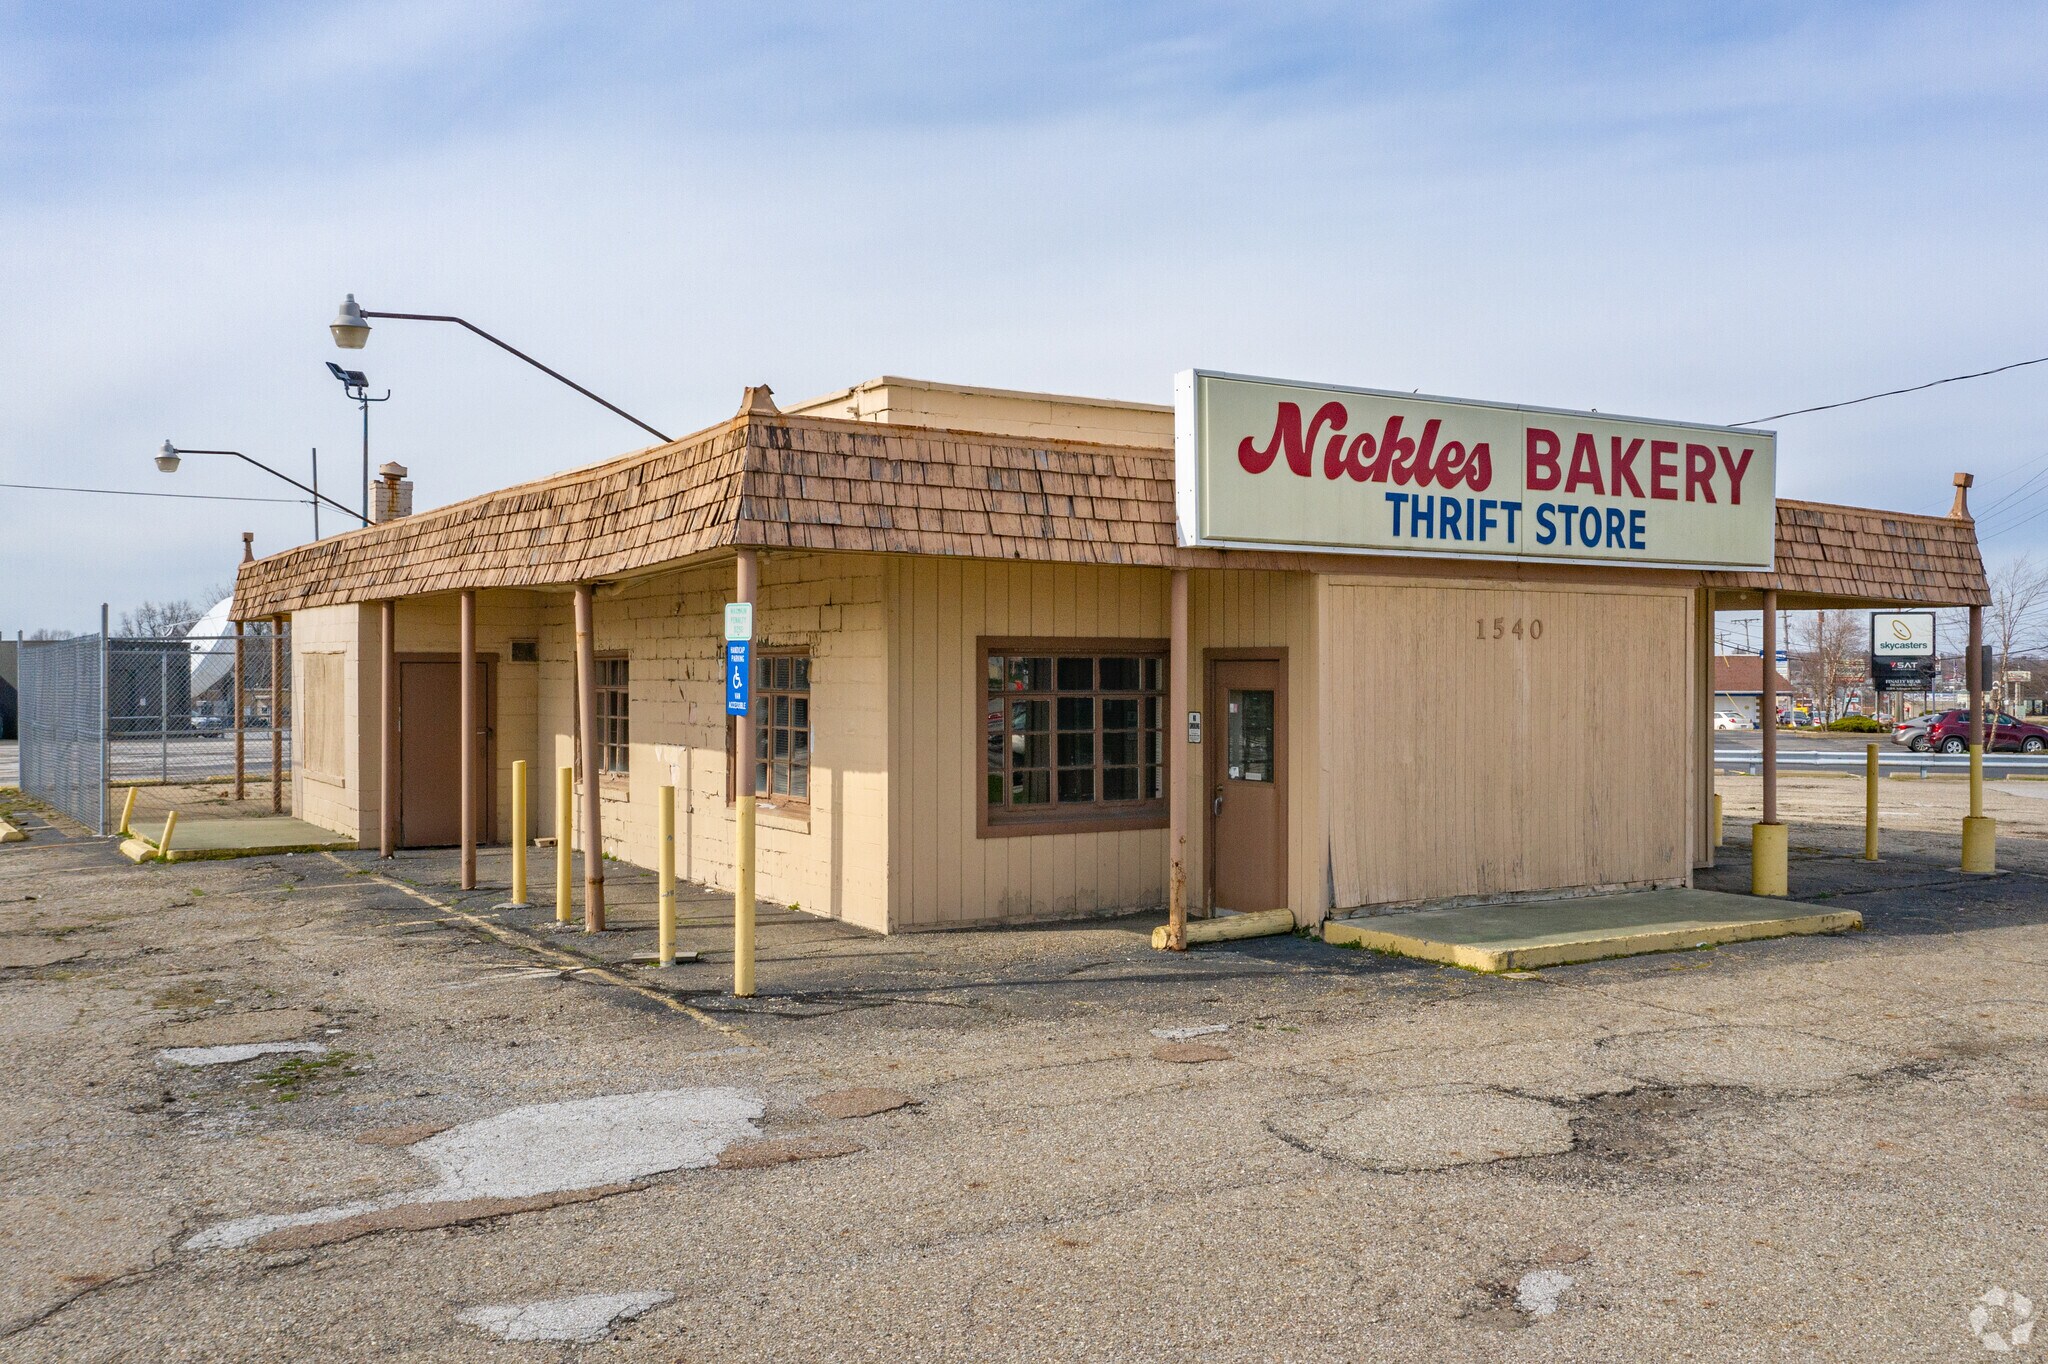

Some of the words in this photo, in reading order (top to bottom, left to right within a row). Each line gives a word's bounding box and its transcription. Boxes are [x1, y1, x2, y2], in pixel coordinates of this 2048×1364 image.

[1238, 401, 1493, 492] Nickles
[1526, 427, 1754, 504] BAKERY
[1385, 492, 1522, 543] THRIFT
[1536, 503, 1646, 549] STORE
[1476, 617, 1544, 640] 1540
[1880, 641, 1928, 650] skycasters
